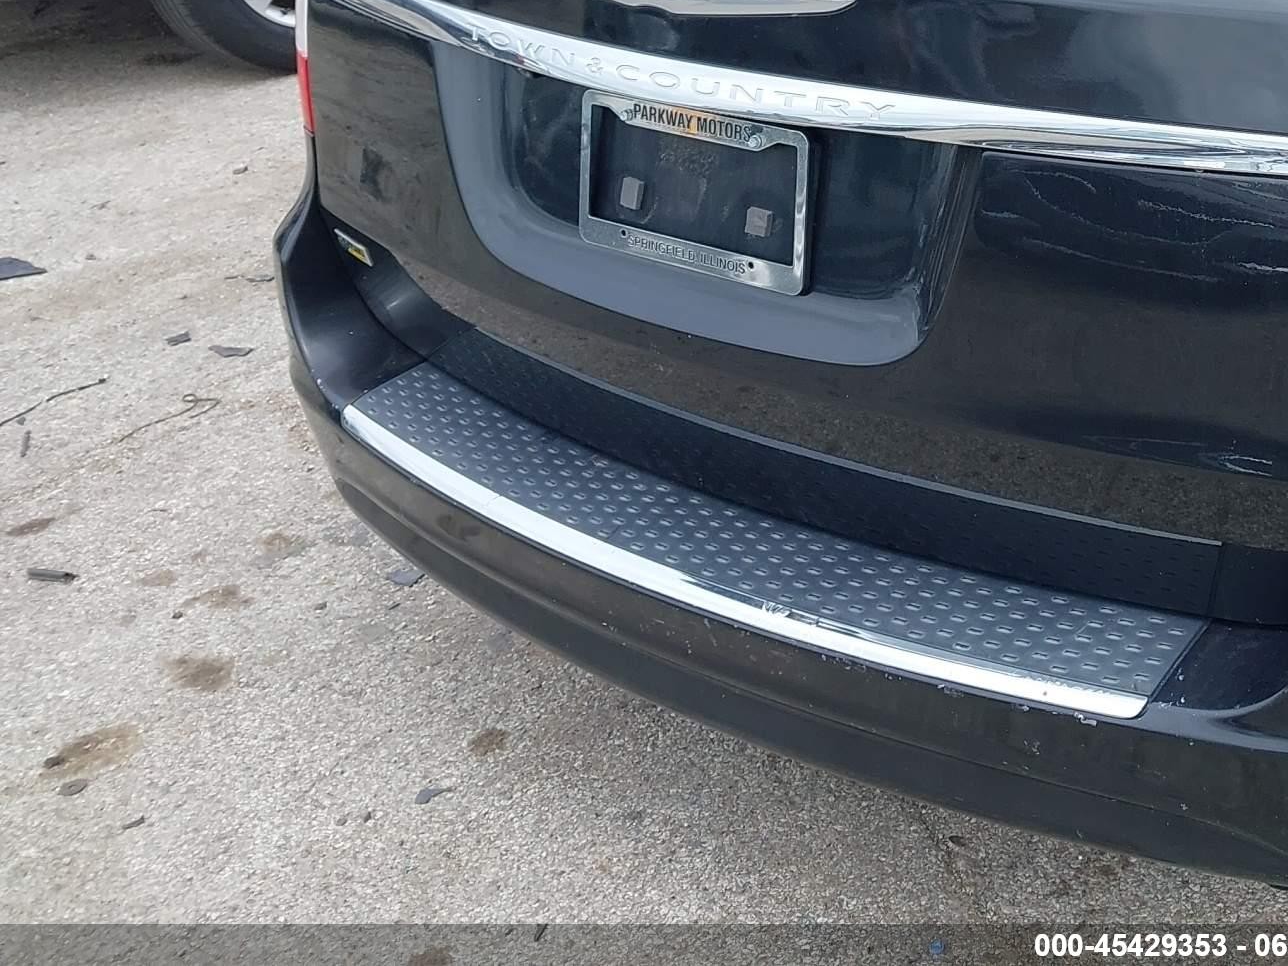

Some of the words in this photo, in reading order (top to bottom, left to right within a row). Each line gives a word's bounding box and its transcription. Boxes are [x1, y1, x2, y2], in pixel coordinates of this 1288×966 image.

[470, 25, 576, 67] TOWN
[616, 64, 897, 121] COUNTRY
[633, 103, 694, 129] PARKWAY
[697, 116, 751, 143] MOTORS
[700, 252, 746, 274] ILLINOIS
